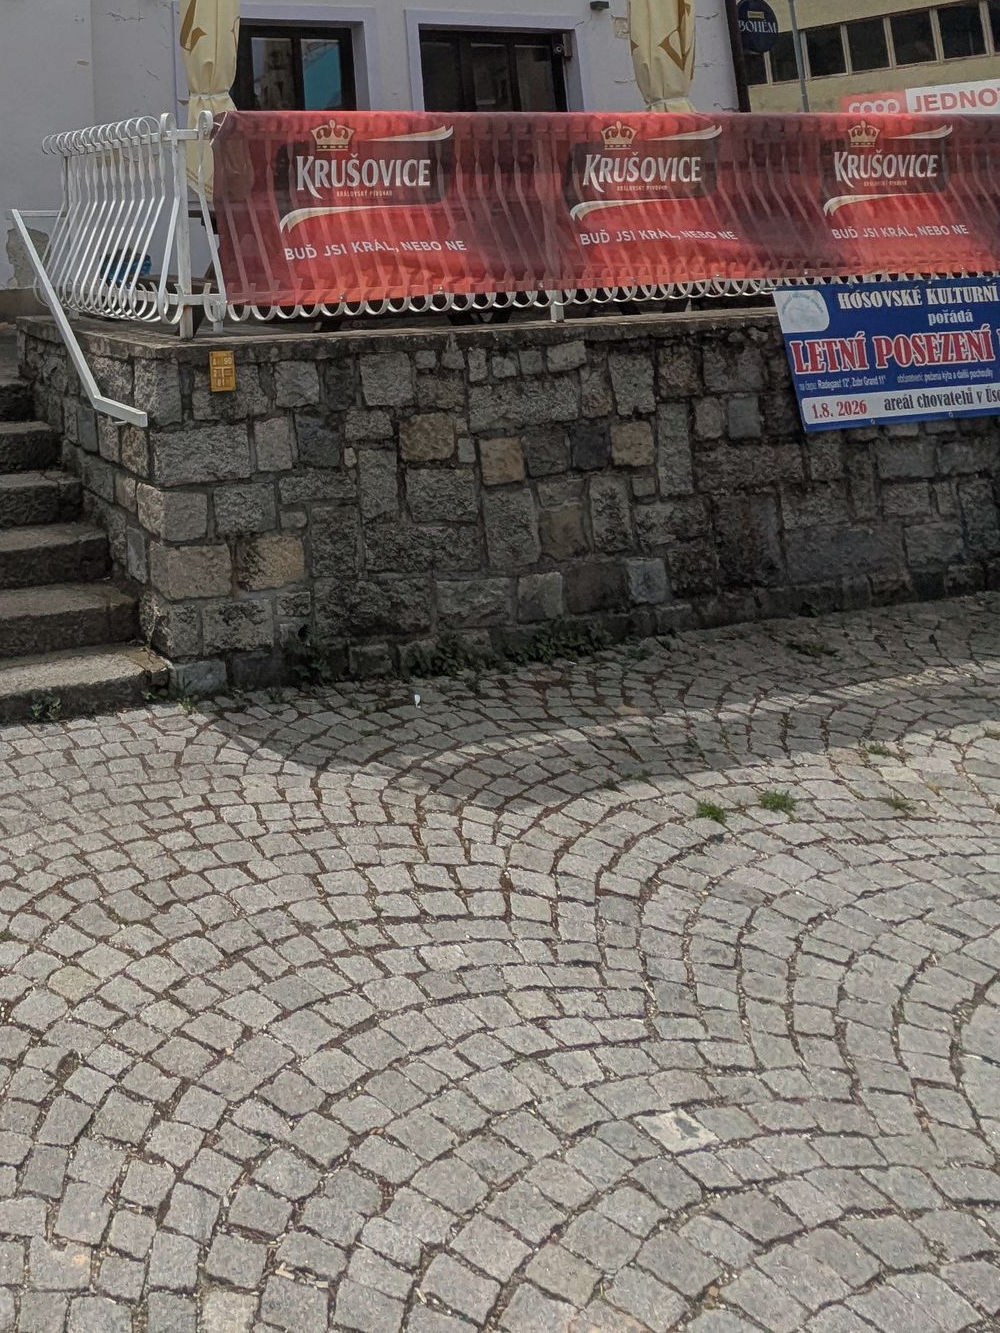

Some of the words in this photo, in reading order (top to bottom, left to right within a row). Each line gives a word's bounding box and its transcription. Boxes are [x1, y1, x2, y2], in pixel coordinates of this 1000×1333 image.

[738, 19, 777, 34] BOHÉM
[914, 87, 1000, 113] JEDNO
[296, 154, 431, 200] KRUŠOVICE
[582, 152, 702, 193] KRUŠOVICE
[834, 149, 939, 188] KRUŠOVICE
[580, 230, 610, 245] BUĎ
[616, 230, 636, 242] JSI
[639, 229, 681, 241] KRÁL,
[680, 229, 717, 240] NEBO
[718, 229, 738, 240] NE
[831, 225, 858, 240] BUĎ
[863, 226, 880, 238] JSI
[880, 223, 918, 238] KRÁL,
[917, 225, 950, 236] NEBO
[951, 224, 970, 235] NE
[284, 244, 317, 261] BUĎ
[323, 244, 347, 257] JSI
[352, 239, 399, 254] KRÁL,
[402, 241, 442, 251] NEBO
[445, 240, 467, 251] NE
[926, 282, 1000, 305] KULTURNÍ
[928, 309, 974, 326] pořádá
[790, 331, 869, 374] LETNÍ
[873, 323, 996, 369] POSEZENÍ
[812, 403, 834, 419] 1.8.
[836, 400, 868, 416] 2026
[884, 394, 914, 411] areál
[917, 387, 974, 409] chovatelů
[976, 391, 982, 404] v
